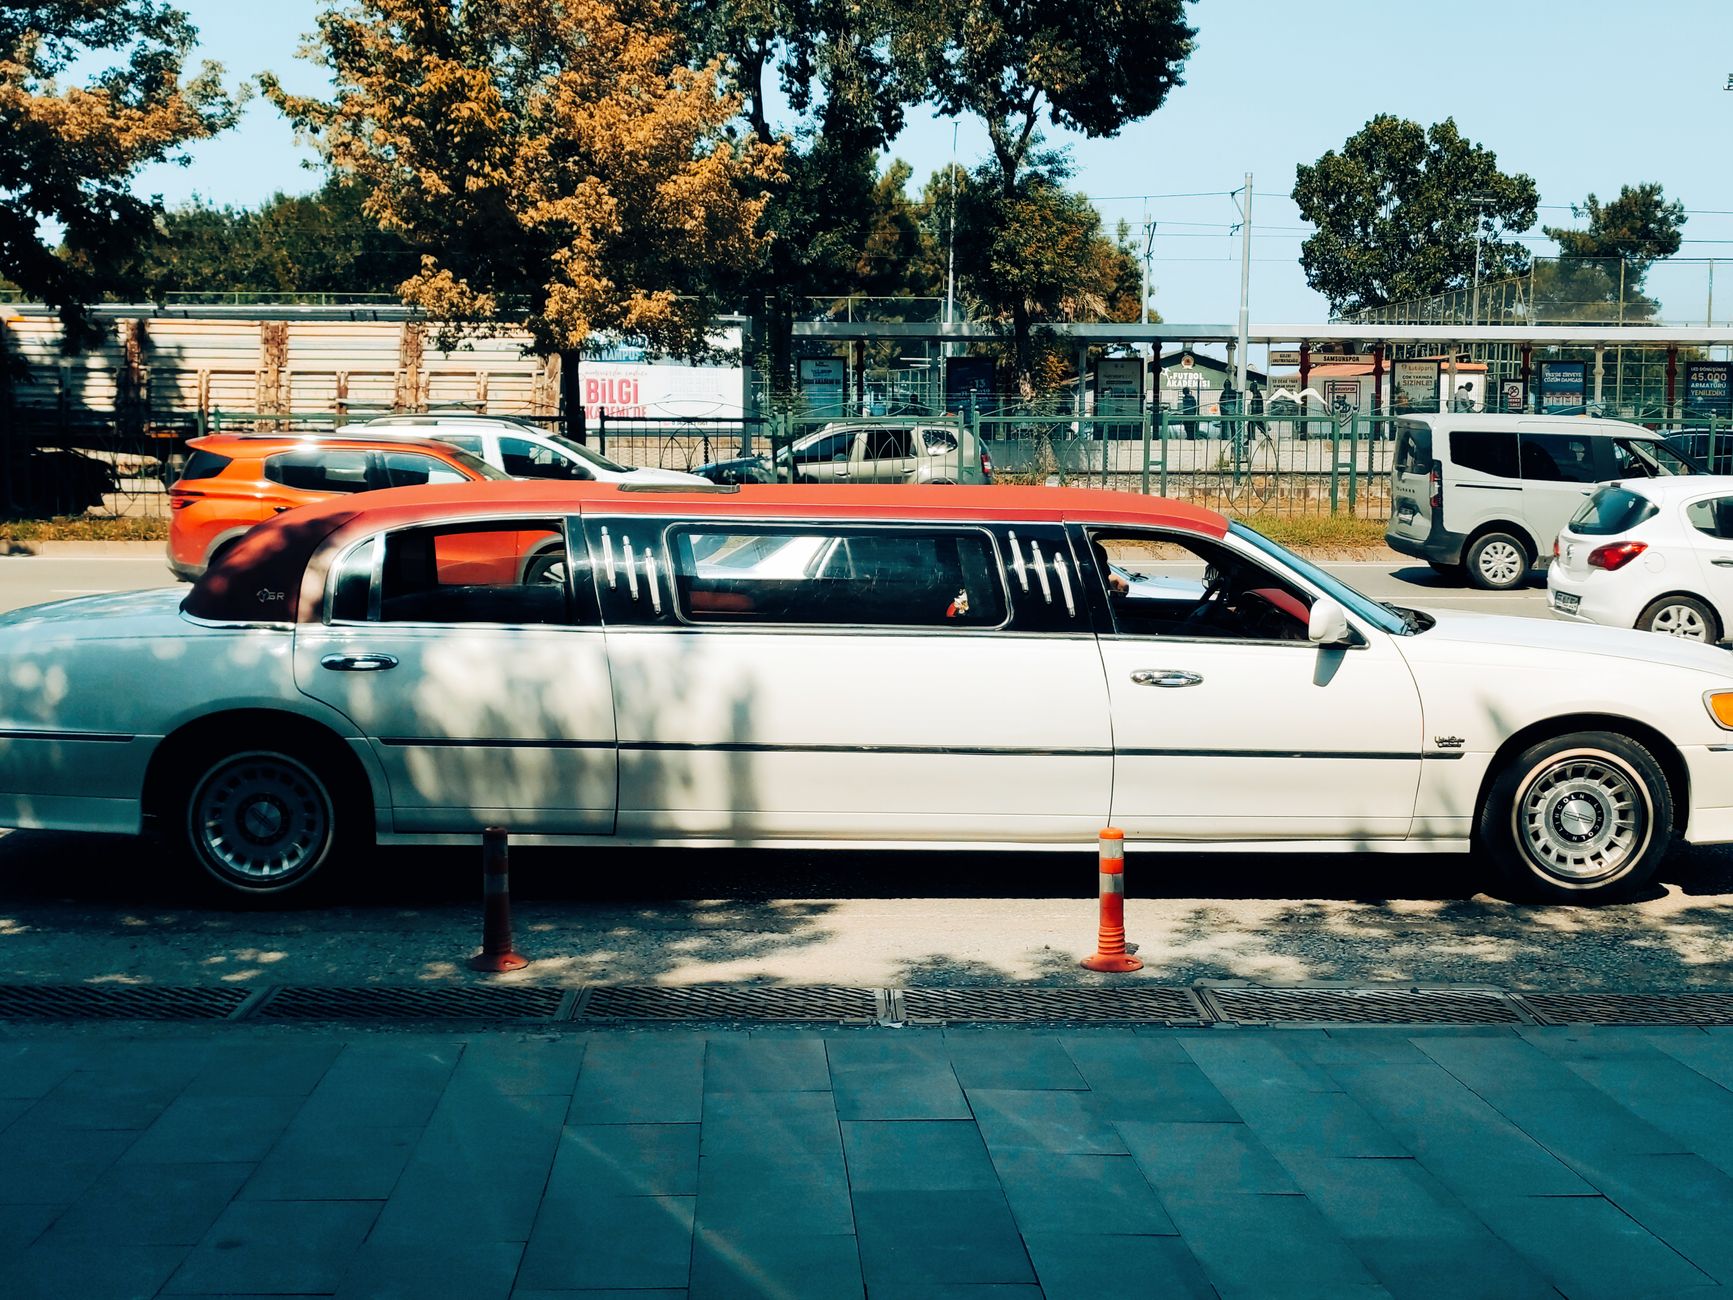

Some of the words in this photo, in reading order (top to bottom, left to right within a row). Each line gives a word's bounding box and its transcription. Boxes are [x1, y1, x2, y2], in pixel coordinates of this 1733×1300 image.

[1173, 372, 1204, 380] FUTBOL
[1691, 373, 1727, 381] 45.000
[1554, 794, 1585, 832] LINCOLN
[1572, 803, 1602, 840] LINCOLN
